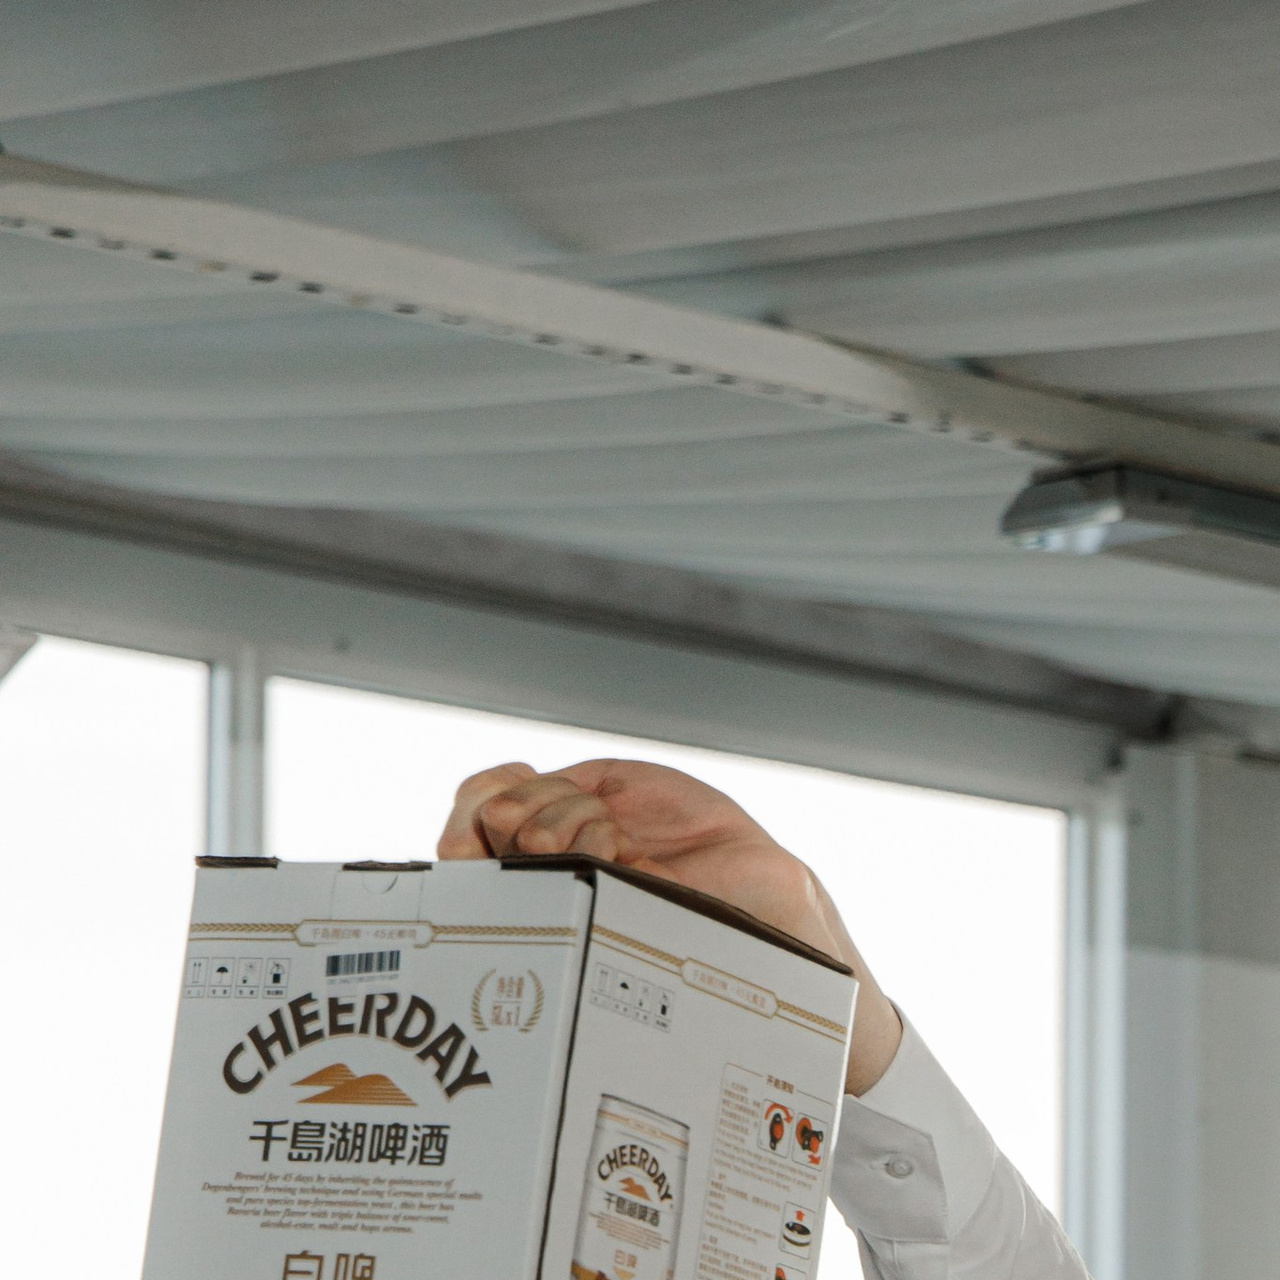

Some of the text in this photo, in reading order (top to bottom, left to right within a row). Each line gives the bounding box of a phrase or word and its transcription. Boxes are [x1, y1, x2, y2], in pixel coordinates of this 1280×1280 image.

[222, 992, 492, 1100] CHEERDAY
[249, 1120, 450, 1166] 千島湖啤酒
[597, 1144, 673, 1202] CHEERDAY
